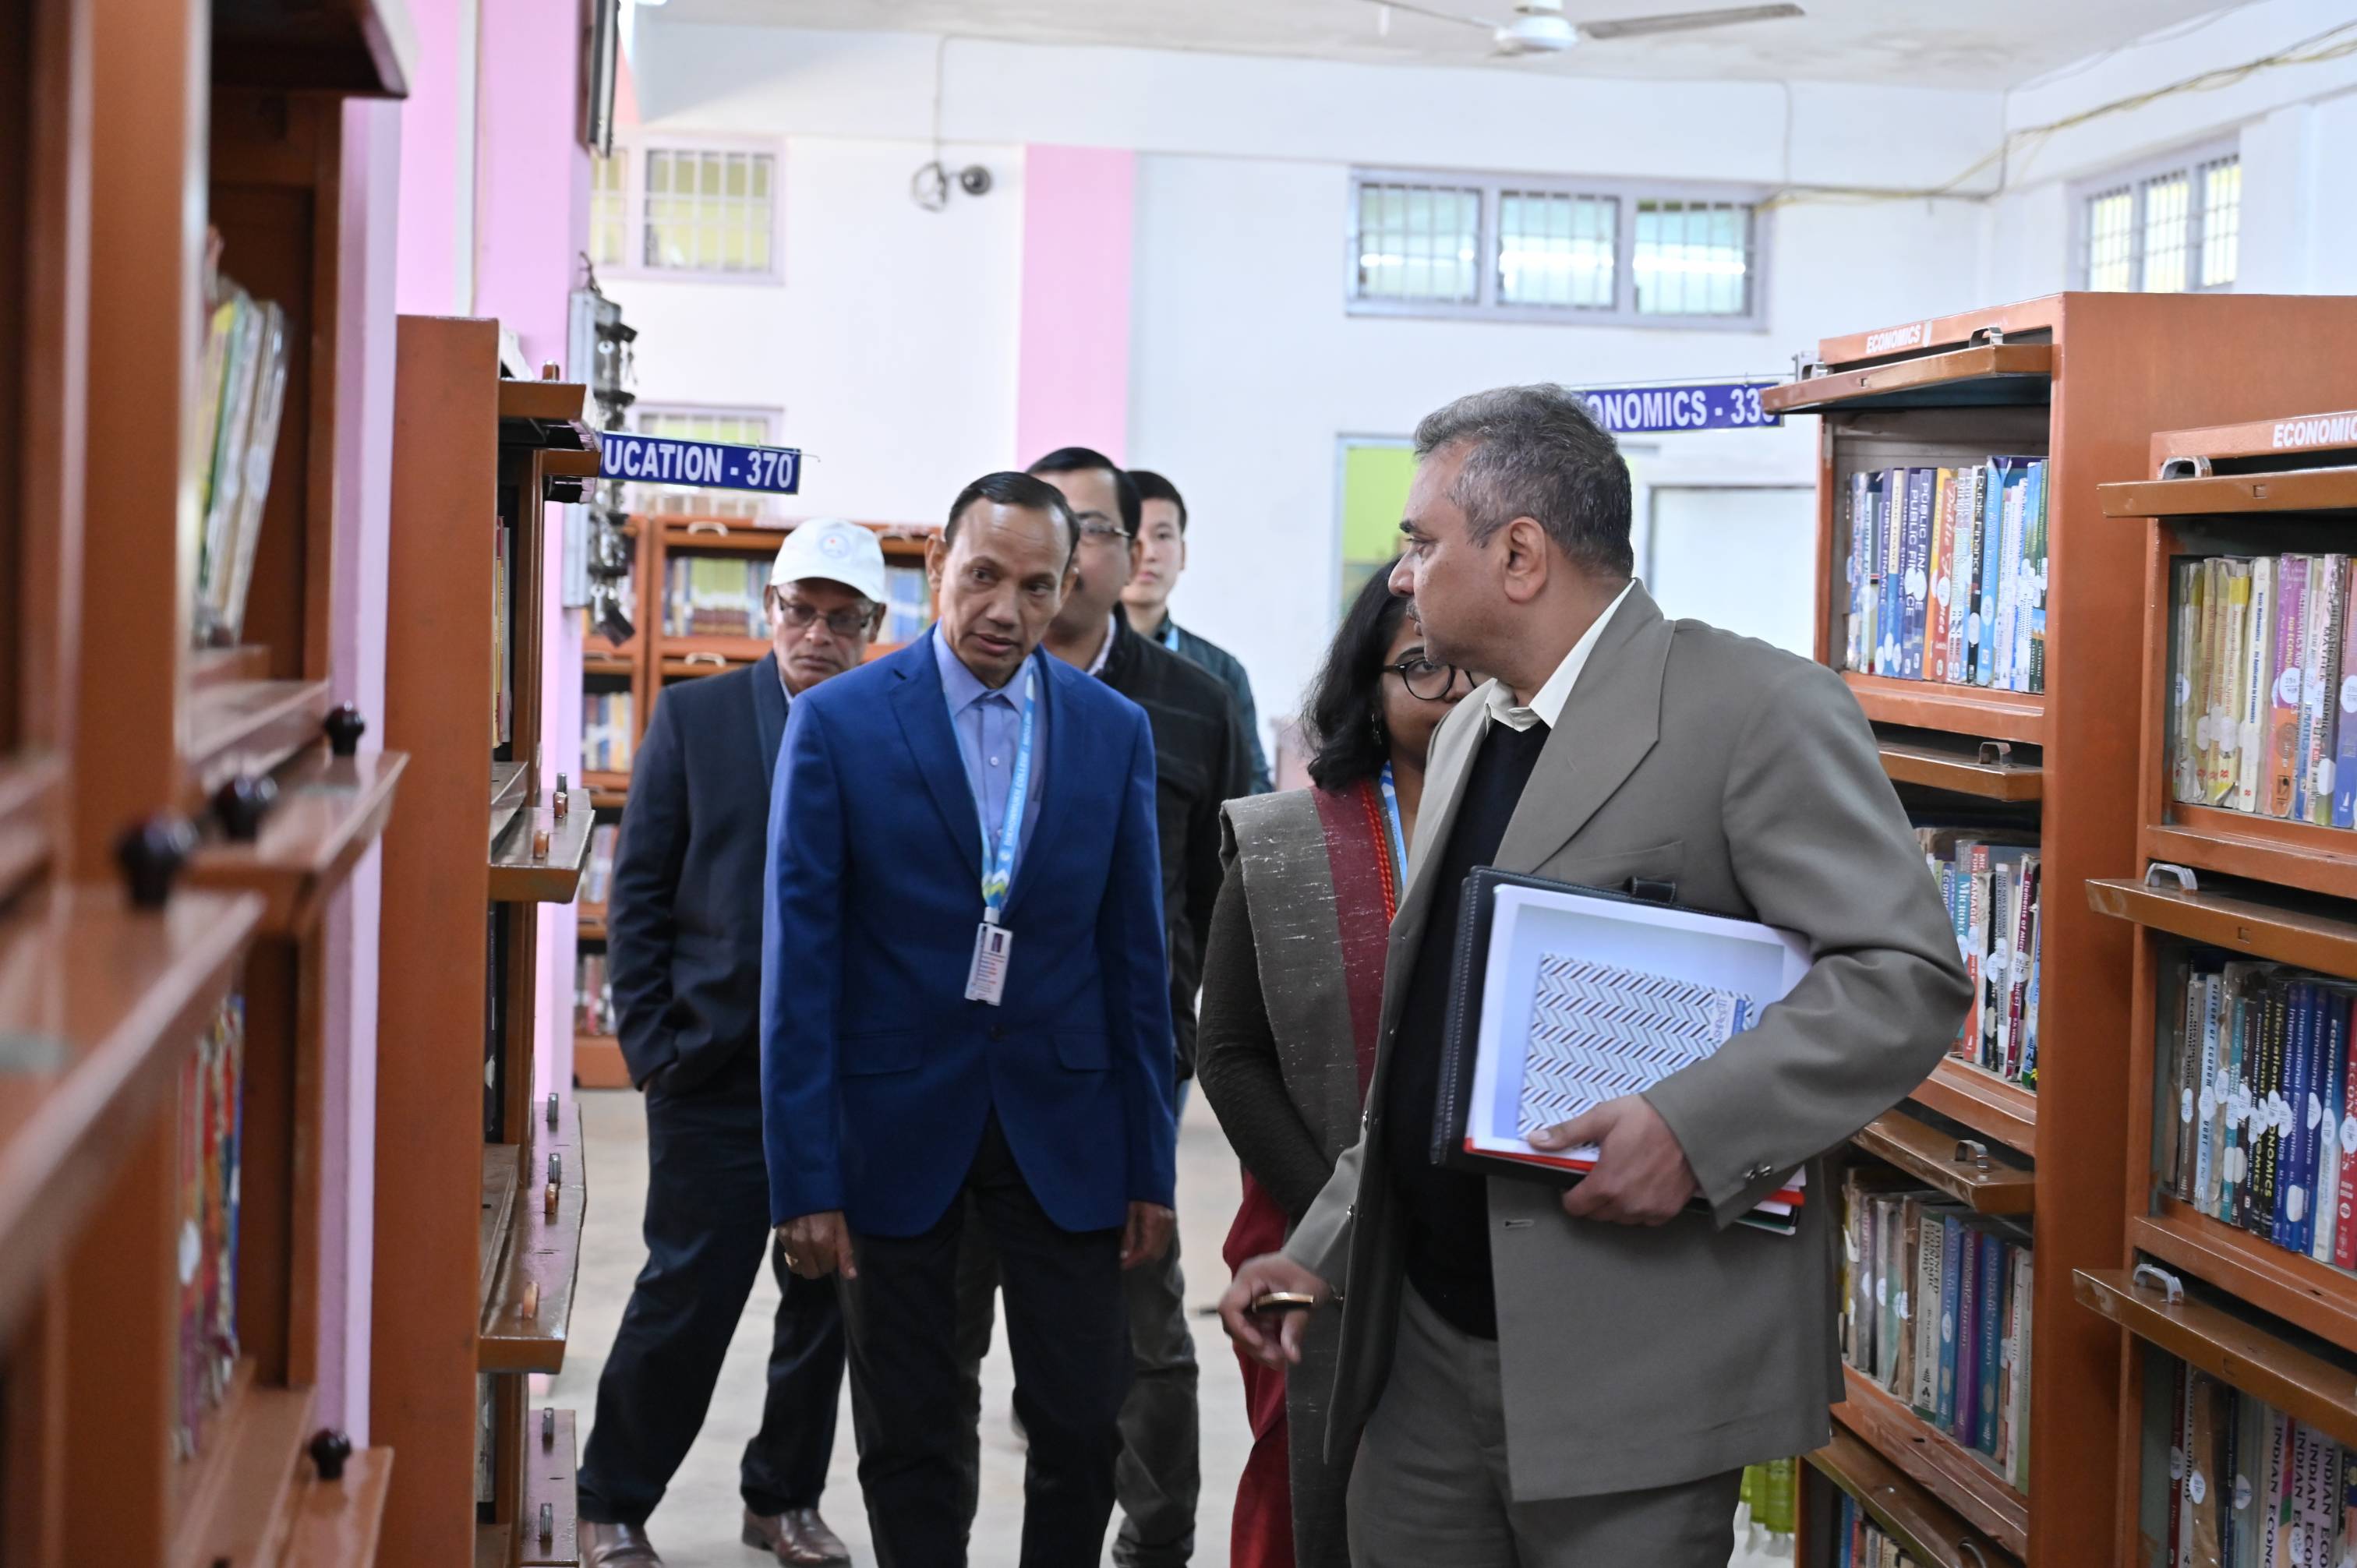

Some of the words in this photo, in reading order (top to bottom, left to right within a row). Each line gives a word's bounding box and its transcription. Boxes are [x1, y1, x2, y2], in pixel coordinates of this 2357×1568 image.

[1866, 324, 1921, 355] ECONOMICS
[746, 450, 793, 489] 370
[1975, 475, 1984, 518] Public
[1909, 489, 1918, 546] PUBLIC
[1919, 482, 1929, 539] PUBLIC
[1880, 549, 1889, 606] FINANCE
[1915, 544, 1926, 611] FINE
[1972, 521, 1982, 575] Finance
[2295, 588, 2306, 649] MATHEMATICS
[2294, 651, 2302, 666] AND
[2020, 920, 2027, 930] of
[2021, 880, 2030, 920] Elements
[2253, 1054, 2261, 1083] History
[2260, 999, 2271, 1094] International
[2284, 1008, 2296, 1087] International
[2294, 1008, 2306, 1088] International
[2311, 1010, 2323, 1090] International
[2325, 1019, 2338, 1109] ECONOMICS
[2253, 1085, 2259, 1094] of
[2289, 1091, 2301, 1162] Economics
[2253, 1134, 2263, 1192] NOMICS
[2264, 1125, 2275, 1198] ONOMICS
[2270, 1426, 2283, 1493] INDIAN
[2294, 1430, 2306, 1499] INDIAN
[2306, 1442, 2320, 1512] INDIAN
[2322, 1446, 2335, 1517] INDIAN
